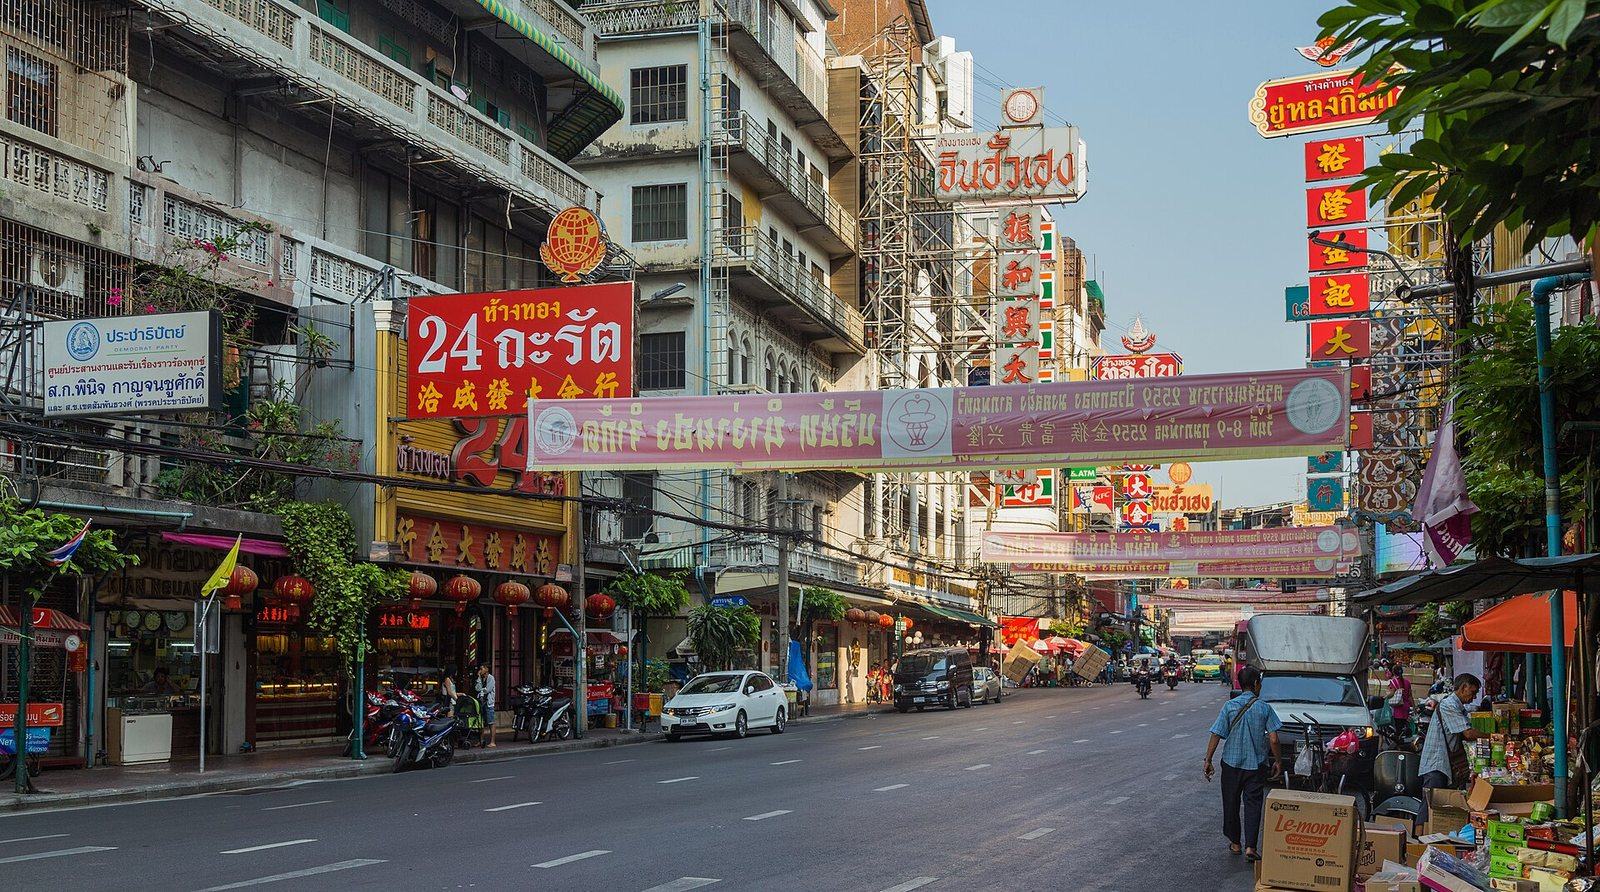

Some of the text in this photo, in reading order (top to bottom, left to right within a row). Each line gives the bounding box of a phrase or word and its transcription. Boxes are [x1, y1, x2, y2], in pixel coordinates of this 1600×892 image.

[483, 298, 561, 323] ห้างทอง
[106, 324, 187, 343] ประชาธิปัตย์
[418, 307, 621, 374] 24 กะรัต
[48, 356, 206, 379] ศูนย์ประสานงานและรับเรื่องราวร้องทุกข์
[48, 366, 207, 398] ส.ก.พินิจ กาญจนชูศักดิ์
[48, 404, 63, 412] และ
[1078, 470, 1096, 478] ATM
[1095, 491, 1110, 501] KFC
[1275, 814, 1342, 837] Le-mond
